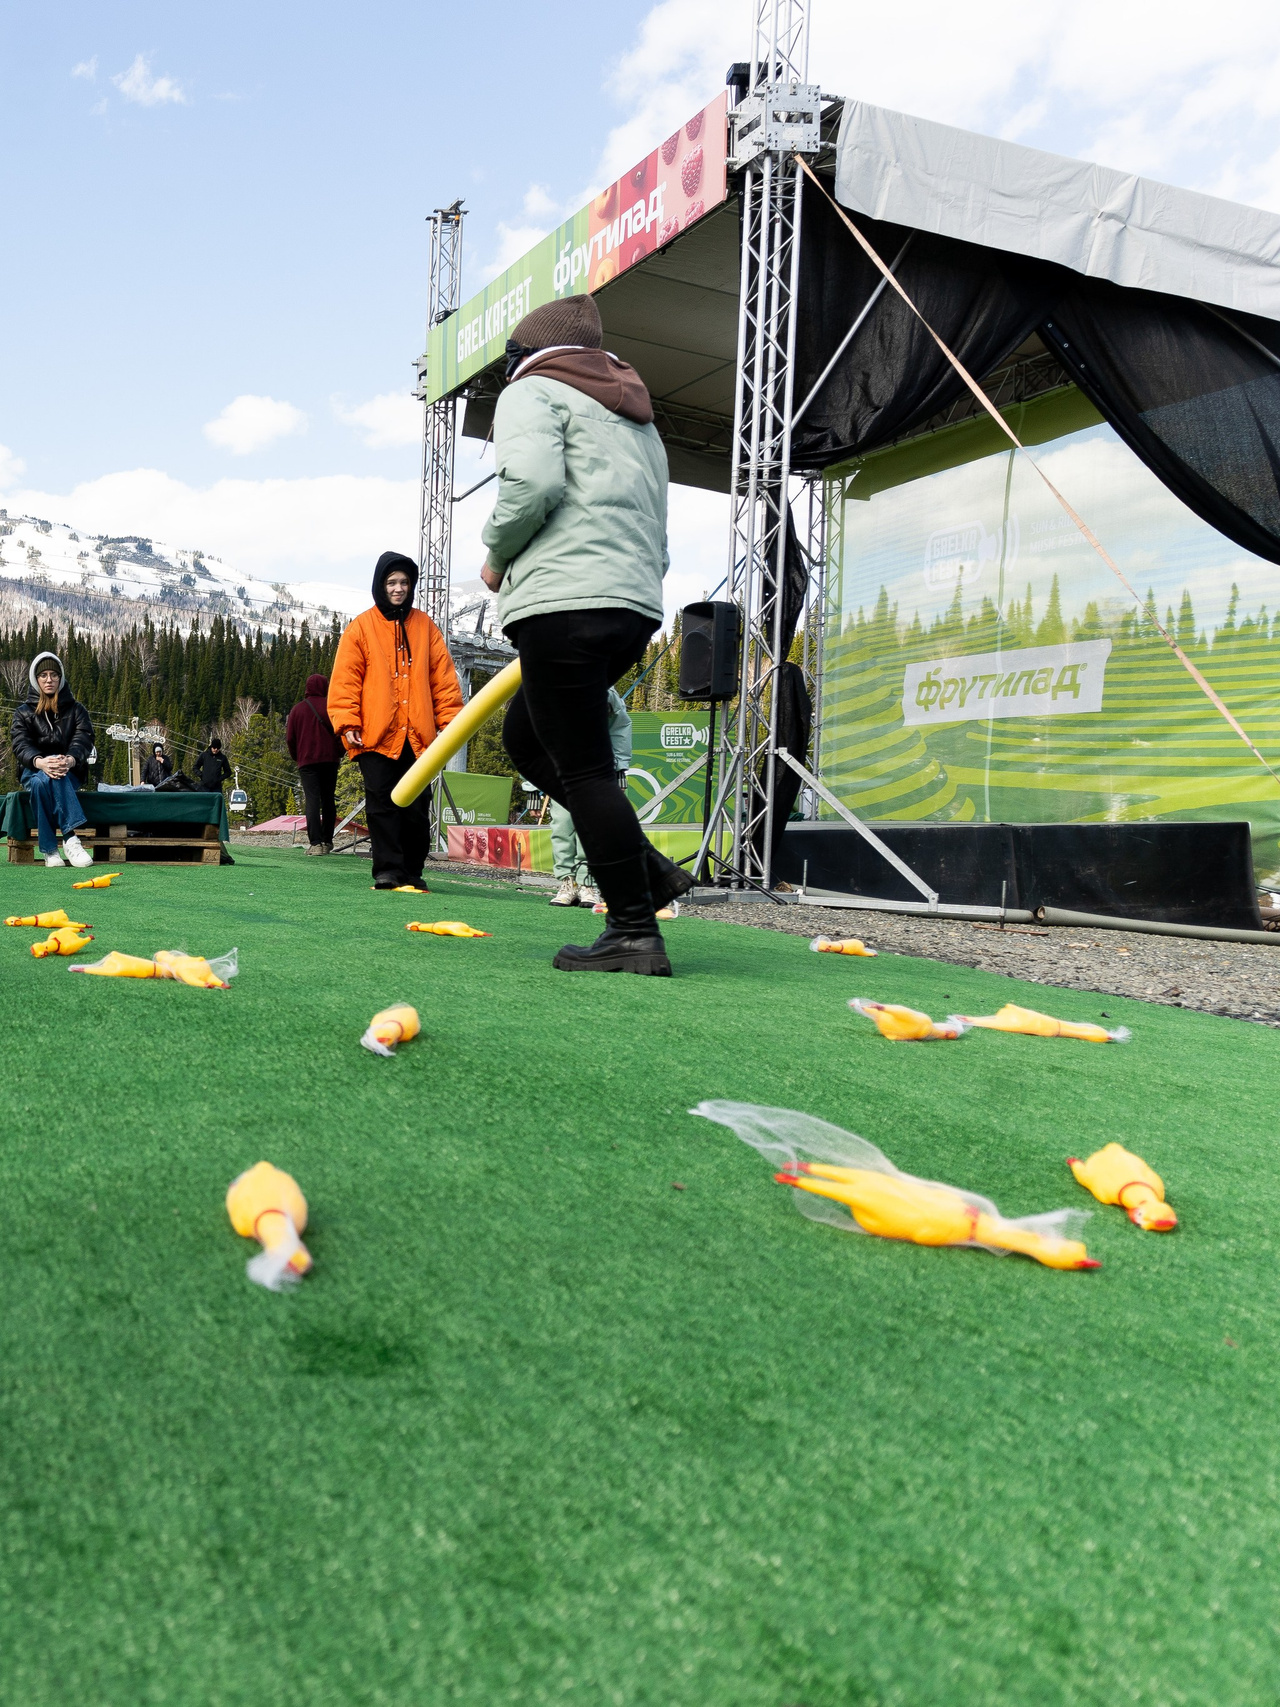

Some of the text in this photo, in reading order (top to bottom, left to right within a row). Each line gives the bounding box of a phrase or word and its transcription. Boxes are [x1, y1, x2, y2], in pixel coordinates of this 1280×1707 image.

[457, 275, 532, 363] GRELKAFEST
[665, 726, 691, 735] GRELKA
[666, 736, 684, 745] FEST
